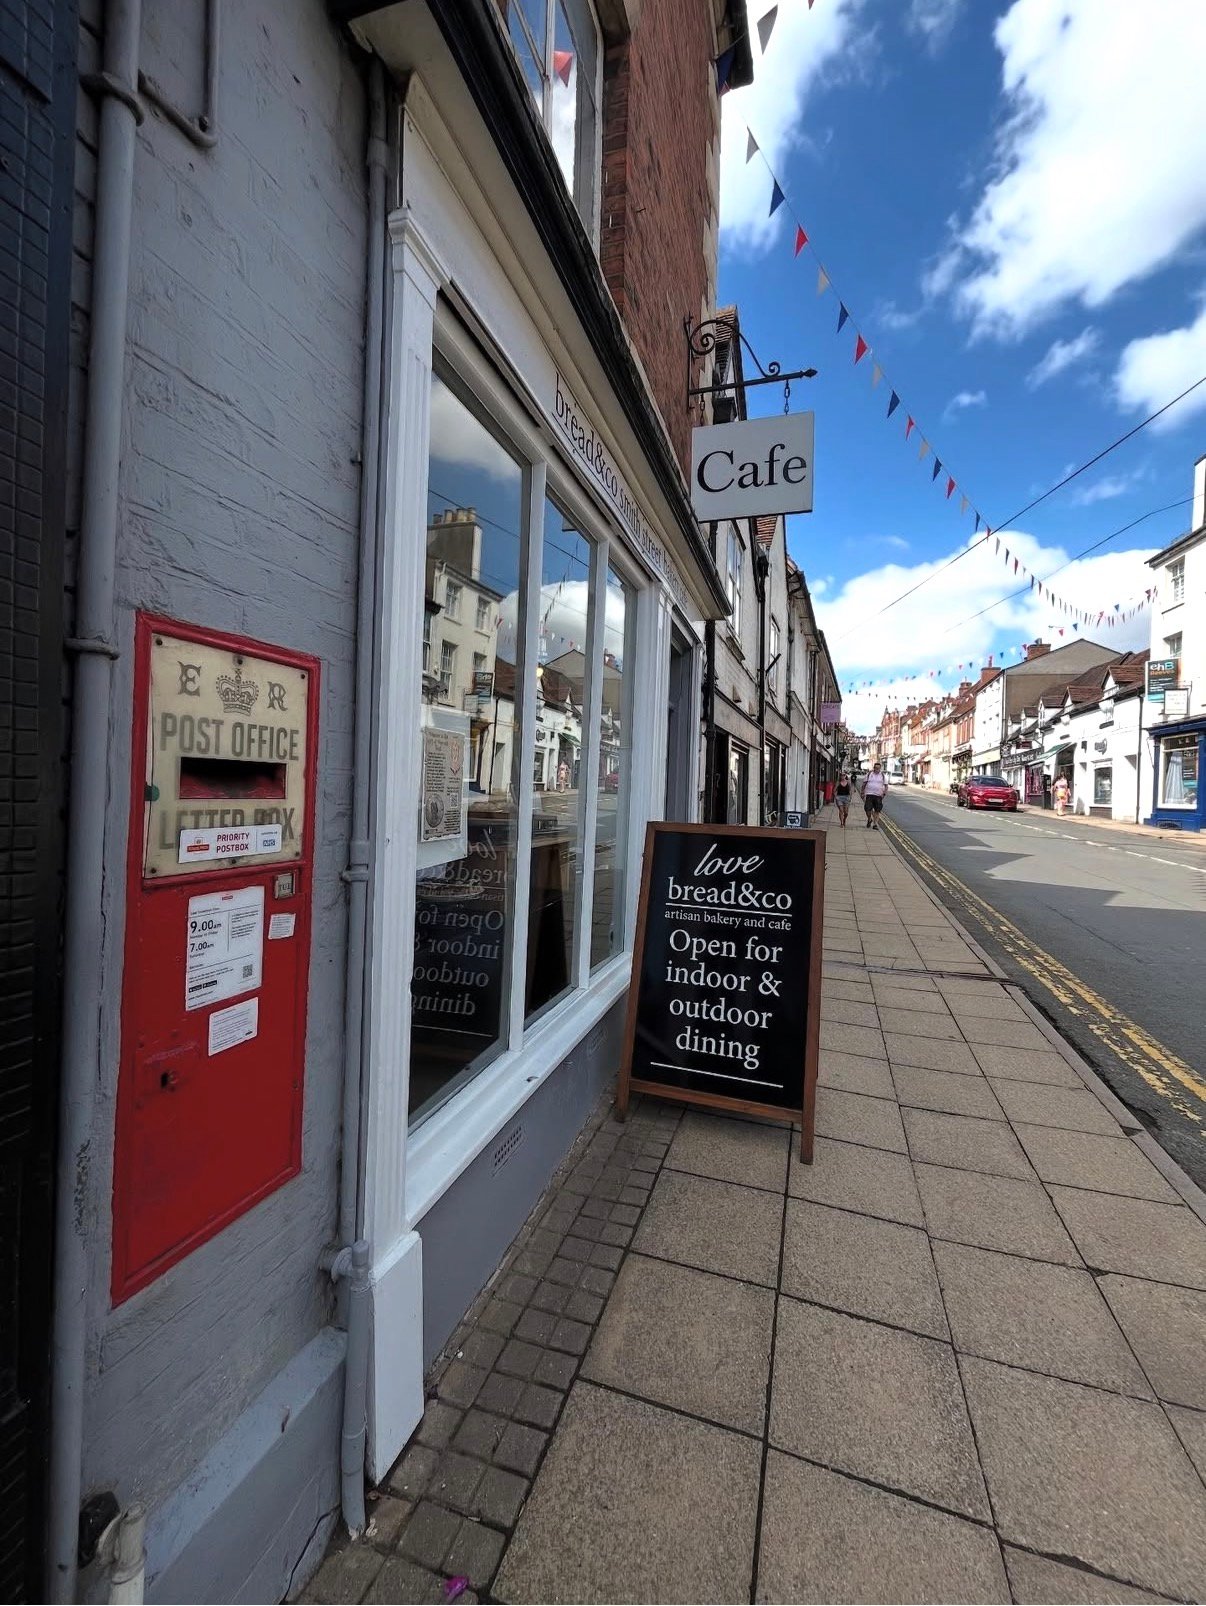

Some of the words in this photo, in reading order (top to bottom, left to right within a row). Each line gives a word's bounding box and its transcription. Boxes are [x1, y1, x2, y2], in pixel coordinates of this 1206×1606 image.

[555, 371, 618, 497] bread&co
[620, 489, 641, 539] smith
[697, 443, 807, 493] Cafe
[177, 660, 202, 697] E
[267, 681, 288, 712] R
[160, 712, 224, 756] POST
[231, 721, 300, 761] OFFICE
[216, 832, 250, 842] PRIORITY
[216, 843, 249, 853] POSTBOX
[693, 843, 765, 877] love
[668, 876, 792, 910] bread&co
[664, 909, 701, 922] artisan
[703, 911, 742, 929] bakery
[744, 916, 765, 928] and
[768, 918, 792, 931] cafe
[669, 929, 737, 961] Open
[745, 936, 783, 963] for
[665, 960, 751, 992] indoor
[758, 971, 783, 997] &
[669, 997, 773, 1029] outdoor
[676, 1026, 761, 1070] dining
